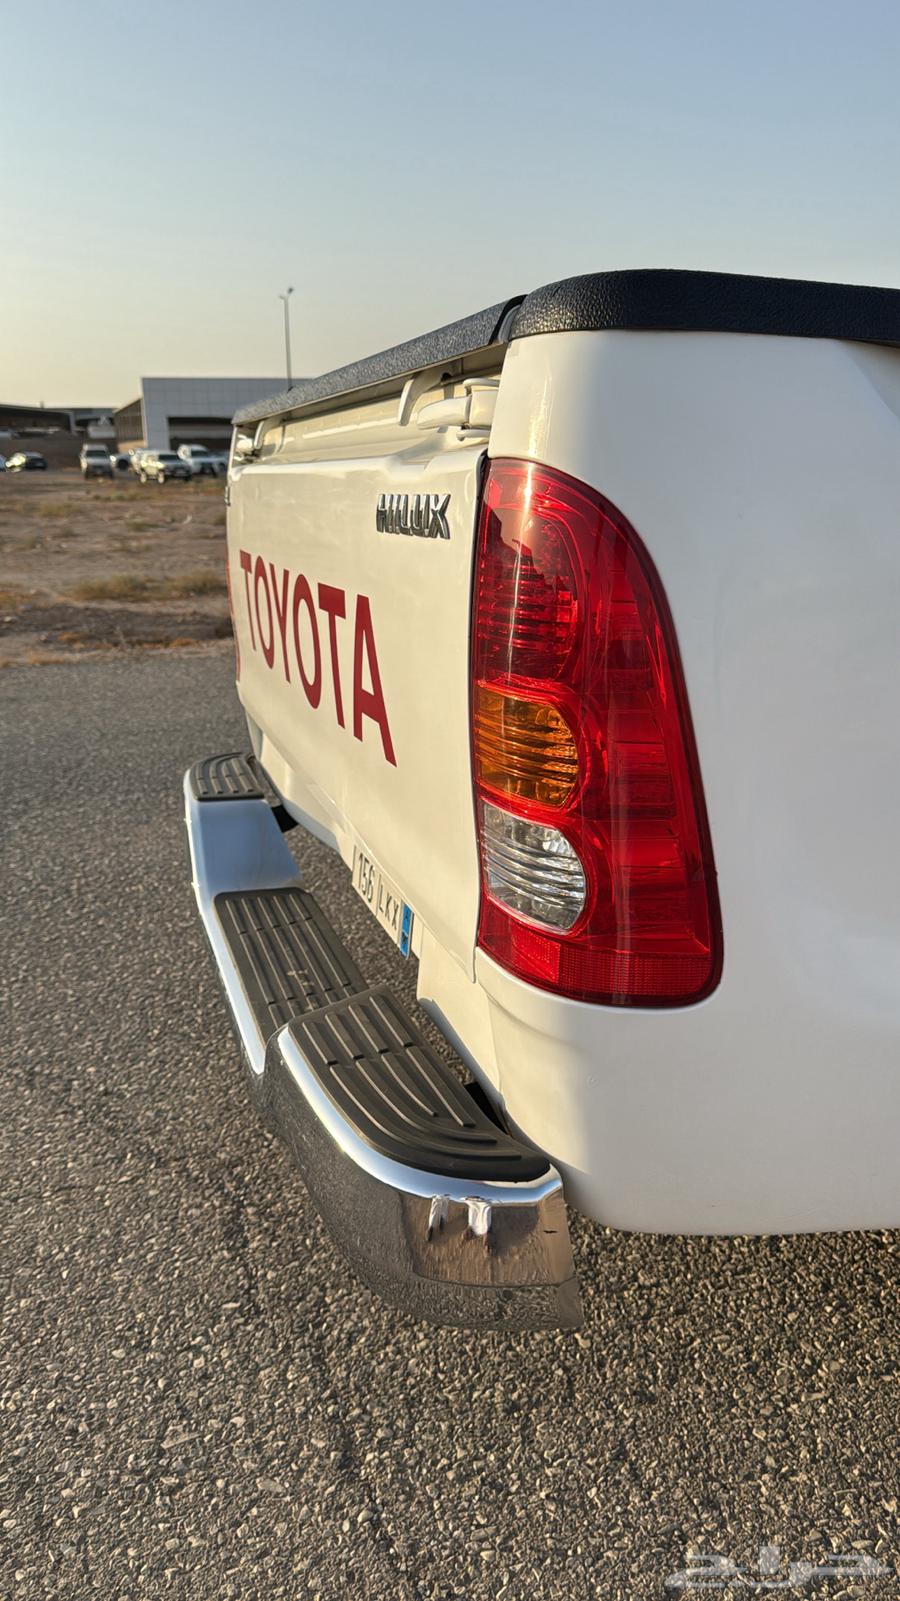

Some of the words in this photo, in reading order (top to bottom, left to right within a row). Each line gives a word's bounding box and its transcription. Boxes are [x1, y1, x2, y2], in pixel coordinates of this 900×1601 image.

[376, 493, 451, 540] HILUX
[239, 549, 397, 767] TOYOTA
[358, 852, 375, 903] 156
[378, 883, 399, 930] LKX
